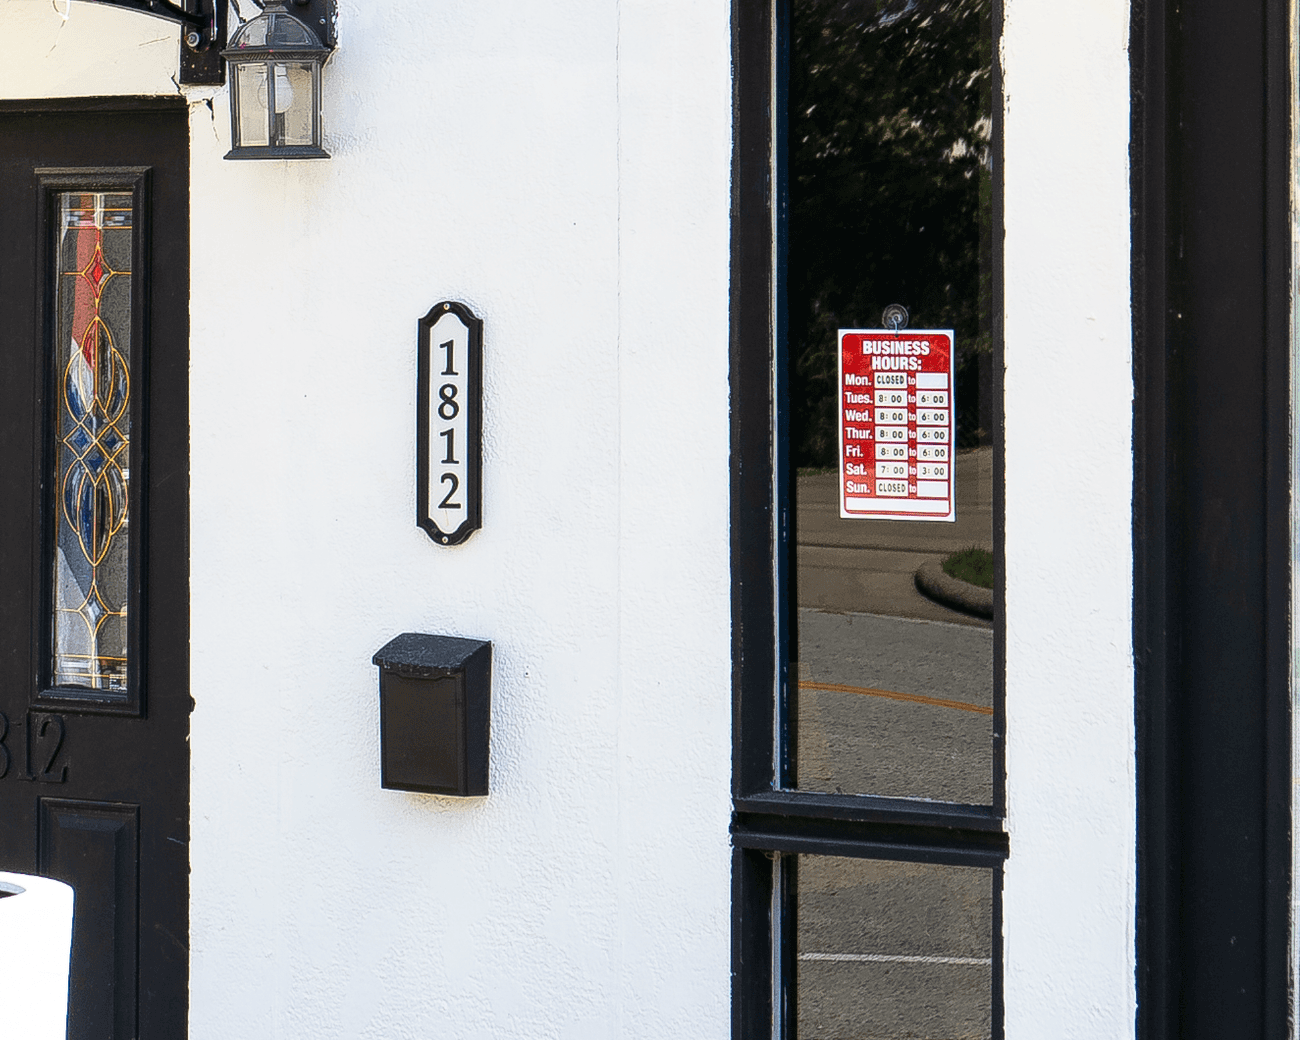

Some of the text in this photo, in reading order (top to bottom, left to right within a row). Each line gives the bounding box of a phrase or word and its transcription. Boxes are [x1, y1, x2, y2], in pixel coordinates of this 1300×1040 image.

[862, 340, 930, 355] BUSINESS
[871, 356, 922, 371] HOURS:
[845, 373, 916, 386] Mon. CLOSED to
[844, 391, 873, 403] Tues.
[908, 394, 916, 403] to
[845, 409, 872, 422] Wed.
[908, 412, 916, 421] to
[437, 339, 462, 509] 1812
[845, 427, 873, 439] Thur.
[908, 430, 916, 439] to
[845, 445, 864, 457] Fri.
[909, 448, 917, 456] to
[846, 463, 867, 475] Sat.
[909, 466, 917, 475] to
[846, 481, 917, 493] Sun. CLOSED to
